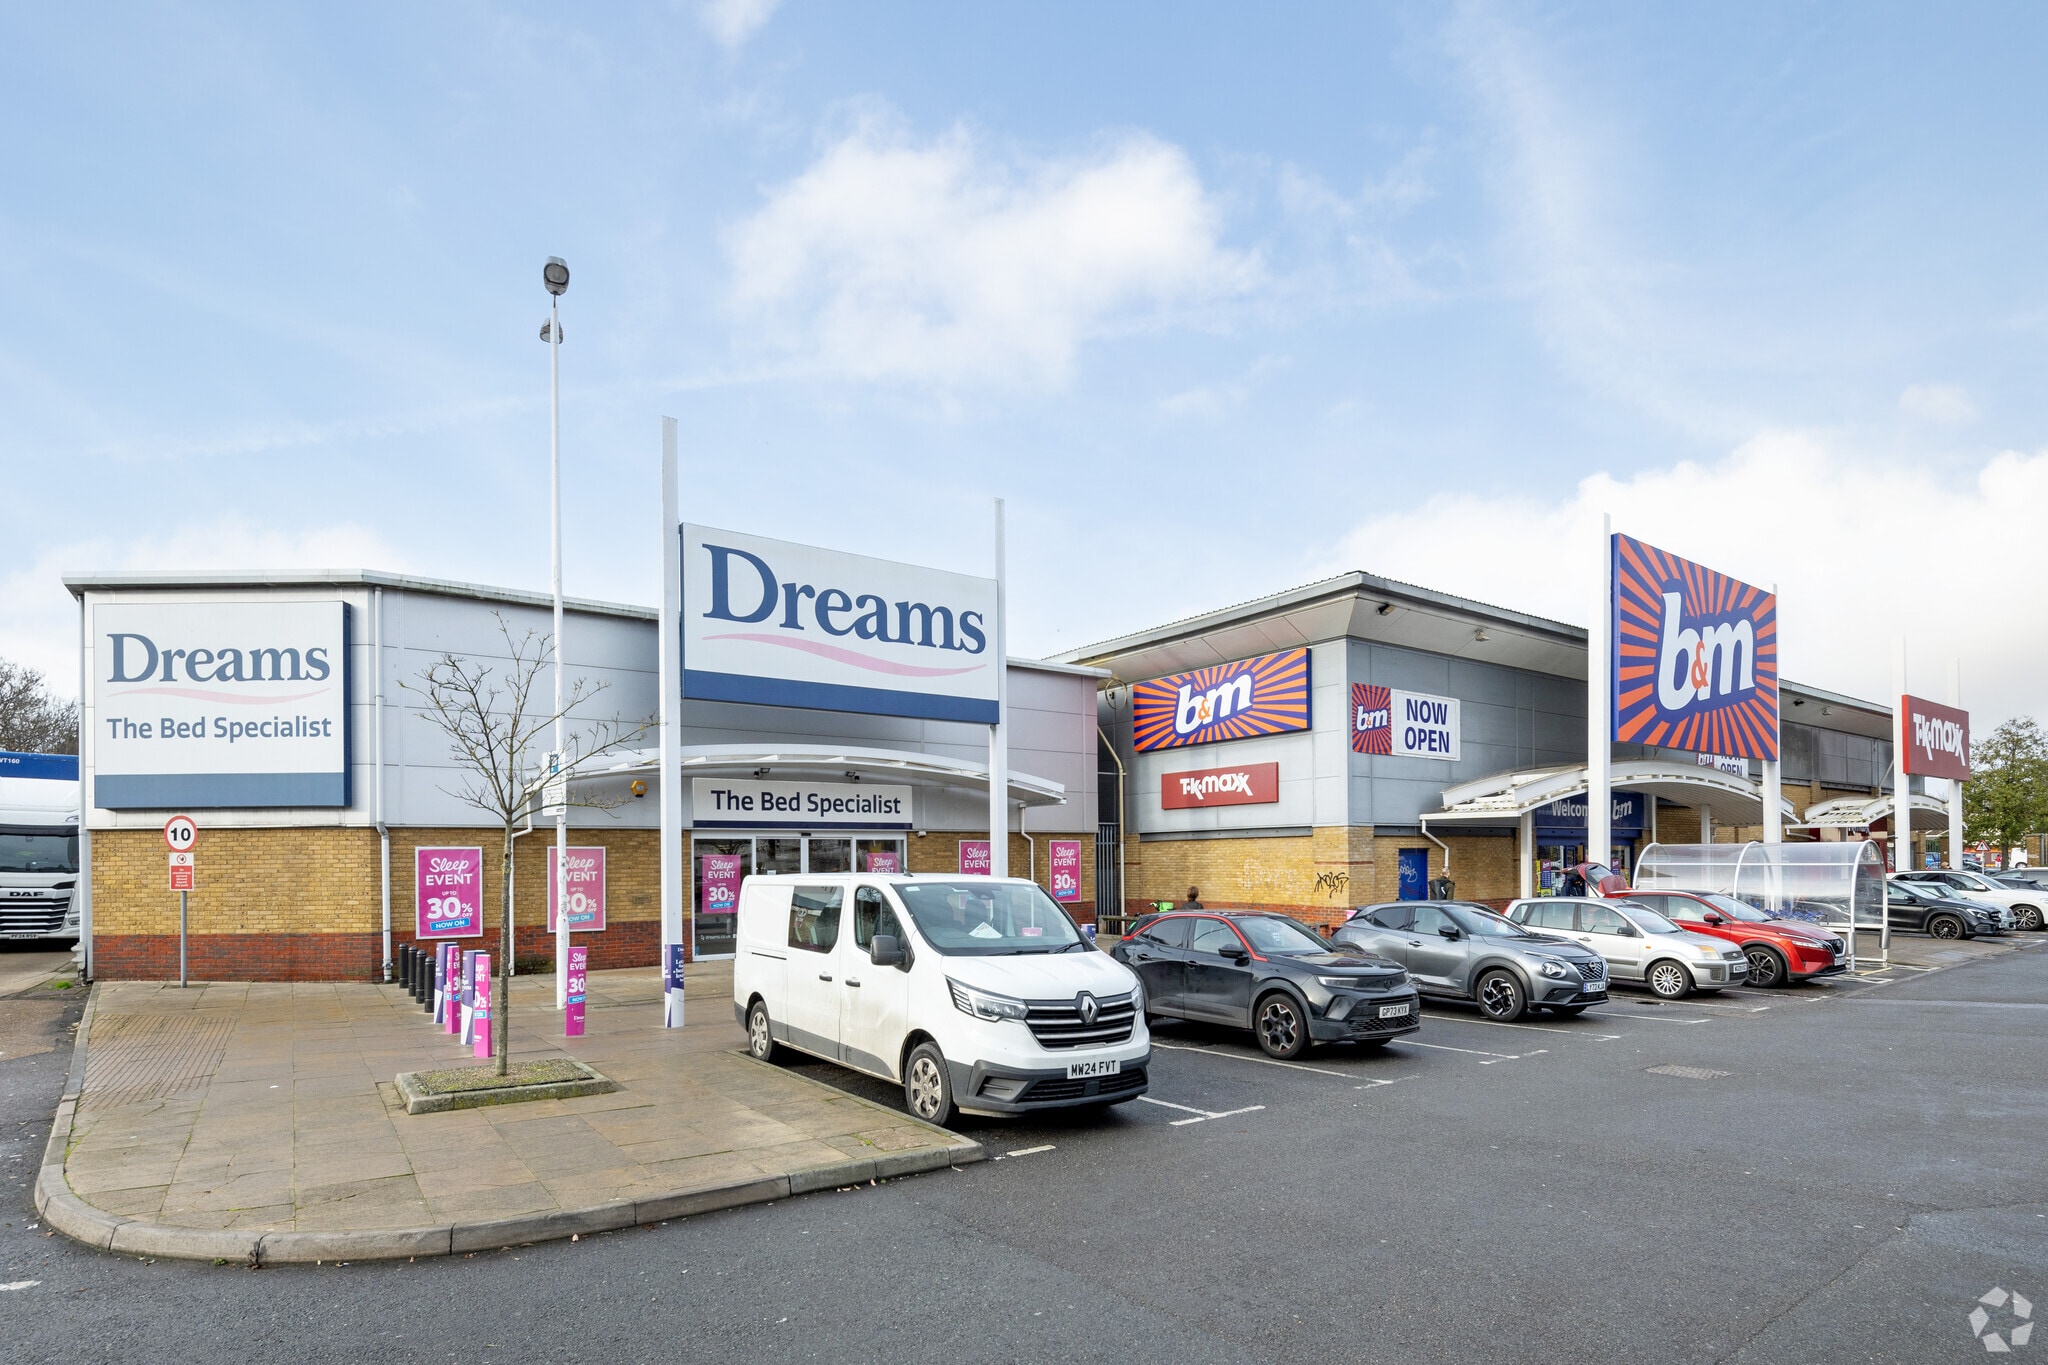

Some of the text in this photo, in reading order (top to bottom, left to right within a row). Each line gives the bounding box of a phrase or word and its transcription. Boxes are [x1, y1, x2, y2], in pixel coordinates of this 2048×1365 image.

[702, 543, 987, 655] Dreams
[106, 633, 331, 682] Dreams
[1406, 698, 1448, 725] NOW
[106, 715, 332, 744] The Bed Specialist
[1405, 726, 1450, 753] OPEN
[710, 789, 901, 817] The Bed Specialist
[170, 827, 191, 841] 10
[966, 847, 988, 860] Sleep
[1055, 846, 1075, 859] Sleep
[428, 857, 470, 874] Sleep
[711, 859, 734, 871] Sleep
[873, 857, 893, 867] Sleep
[964, 860, 990, 868] EVENT
[1053, 858, 1077, 866] EVENT
[425, 873, 473, 886] EVENT
[566, 871, 598, 882] VENT
[708, 871, 736, 879] EVENT
[426, 896, 473, 919] 30%
[435, 919, 465, 929] NOW ON
[1072, 1060, 1116, 1076] MW24 FVT
